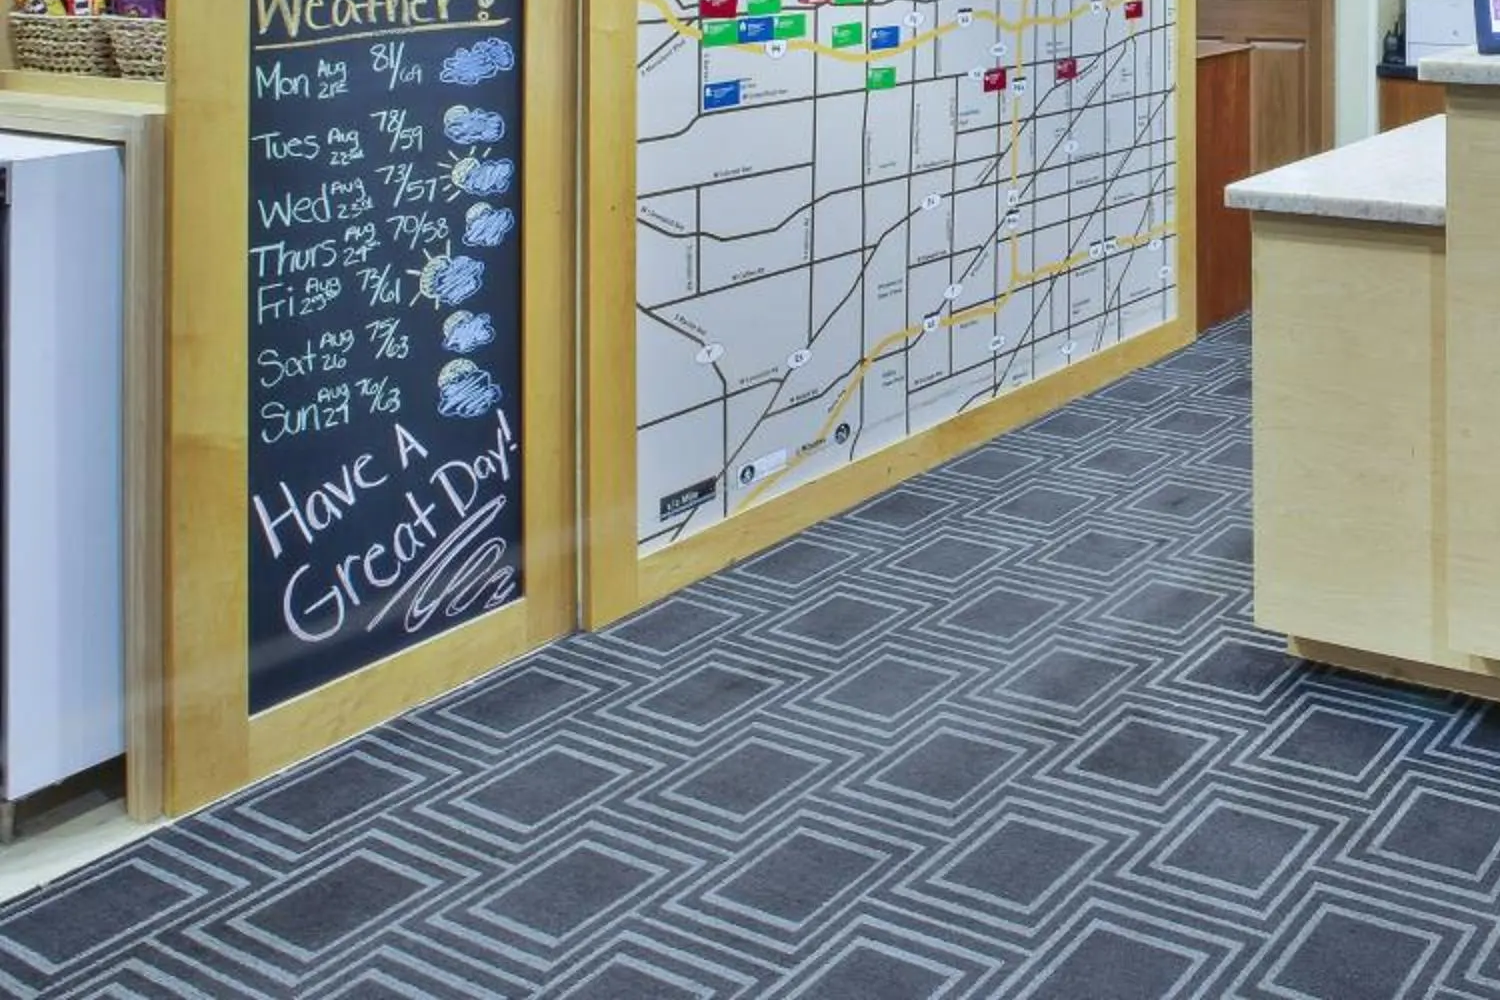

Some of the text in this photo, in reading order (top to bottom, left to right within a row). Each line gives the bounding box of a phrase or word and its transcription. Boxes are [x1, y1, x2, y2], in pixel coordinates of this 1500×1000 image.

[255, 61, 311, 100] Mon
[317, 59, 348, 82] Aug
[250, 131, 321, 161] Tues
[327, 127, 360, 151] Aug
[369, 108, 424, 152] 78/59
[257, 183, 332, 230] Wed
[330, 177, 366, 200] Aug
[375, 162, 438, 208] 73/57
[249, 239, 338, 278] Thurs
[344, 222, 377, 245] Aug
[386, 211, 451, 250] 70/58
[257, 282, 295, 325] Fri
[305, 277, 342, 296] Aug
[356, 263, 402, 308] 73/61
[257, 339, 317, 388] Sat
[319, 328, 355, 353] Aug
[321, 354, 348, 372] 26
[317, 383, 350, 403] Aug
[322, 403, 351, 428] 27
[260, 401, 321, 444] Sun
[253, 423, 429, 559] Have A
[283, 408, 518, 643] Great Day!
